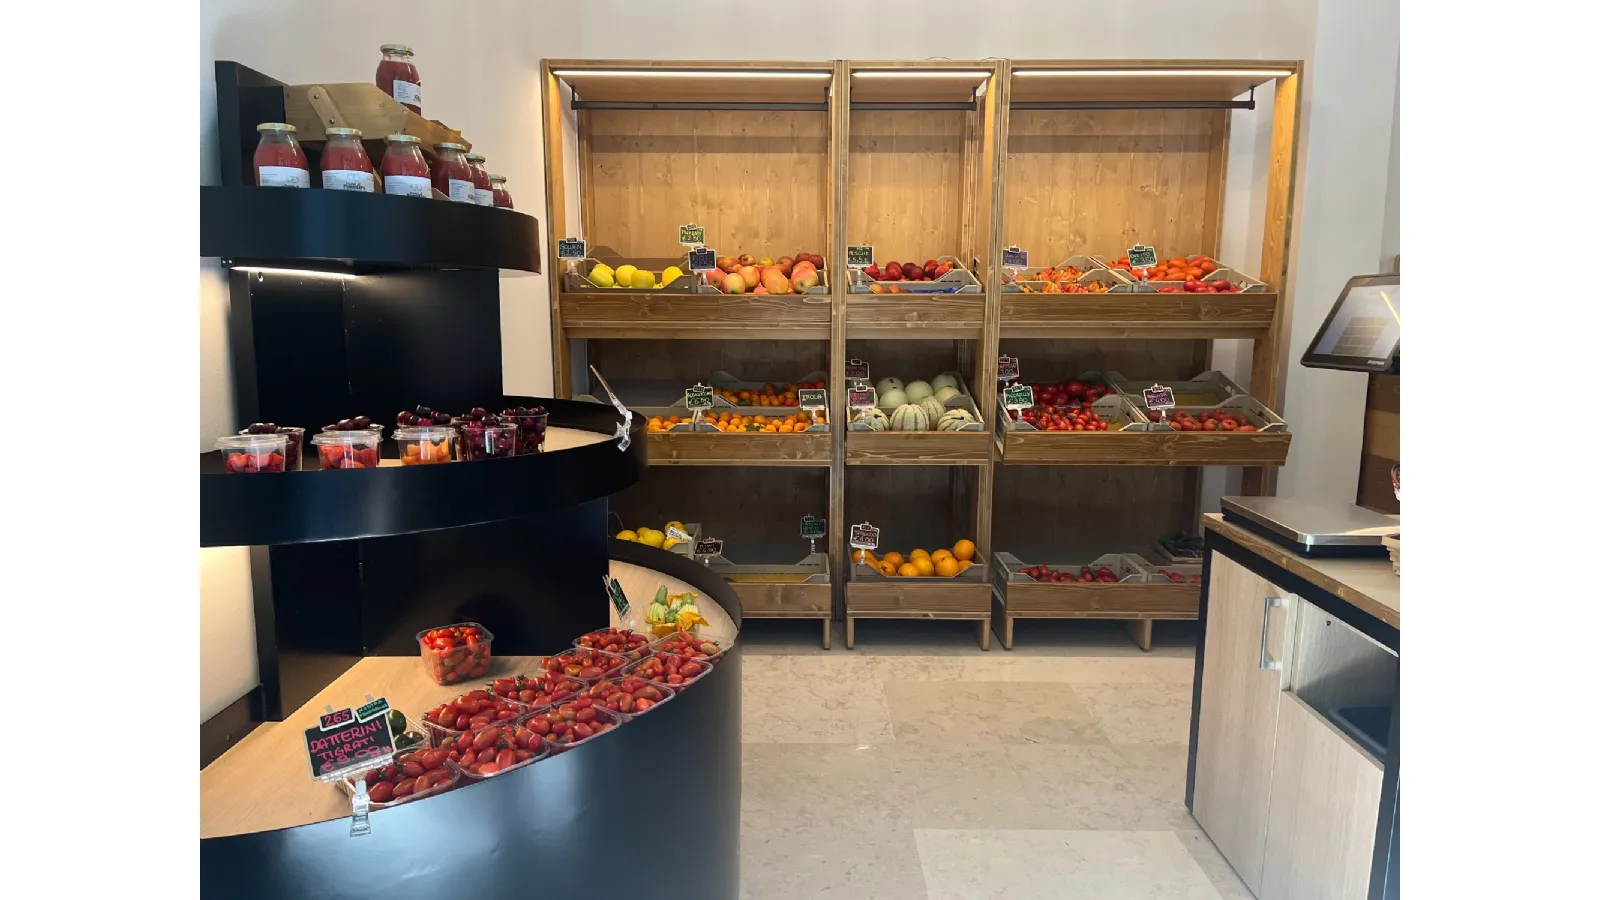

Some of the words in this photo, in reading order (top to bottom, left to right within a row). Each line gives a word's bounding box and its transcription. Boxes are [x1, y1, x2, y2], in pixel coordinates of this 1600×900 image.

[324, 709, 350, 728] 265
[310, 720, 383, 753] DATTERINI
[317, 735, 375, 760] TIGRATI
